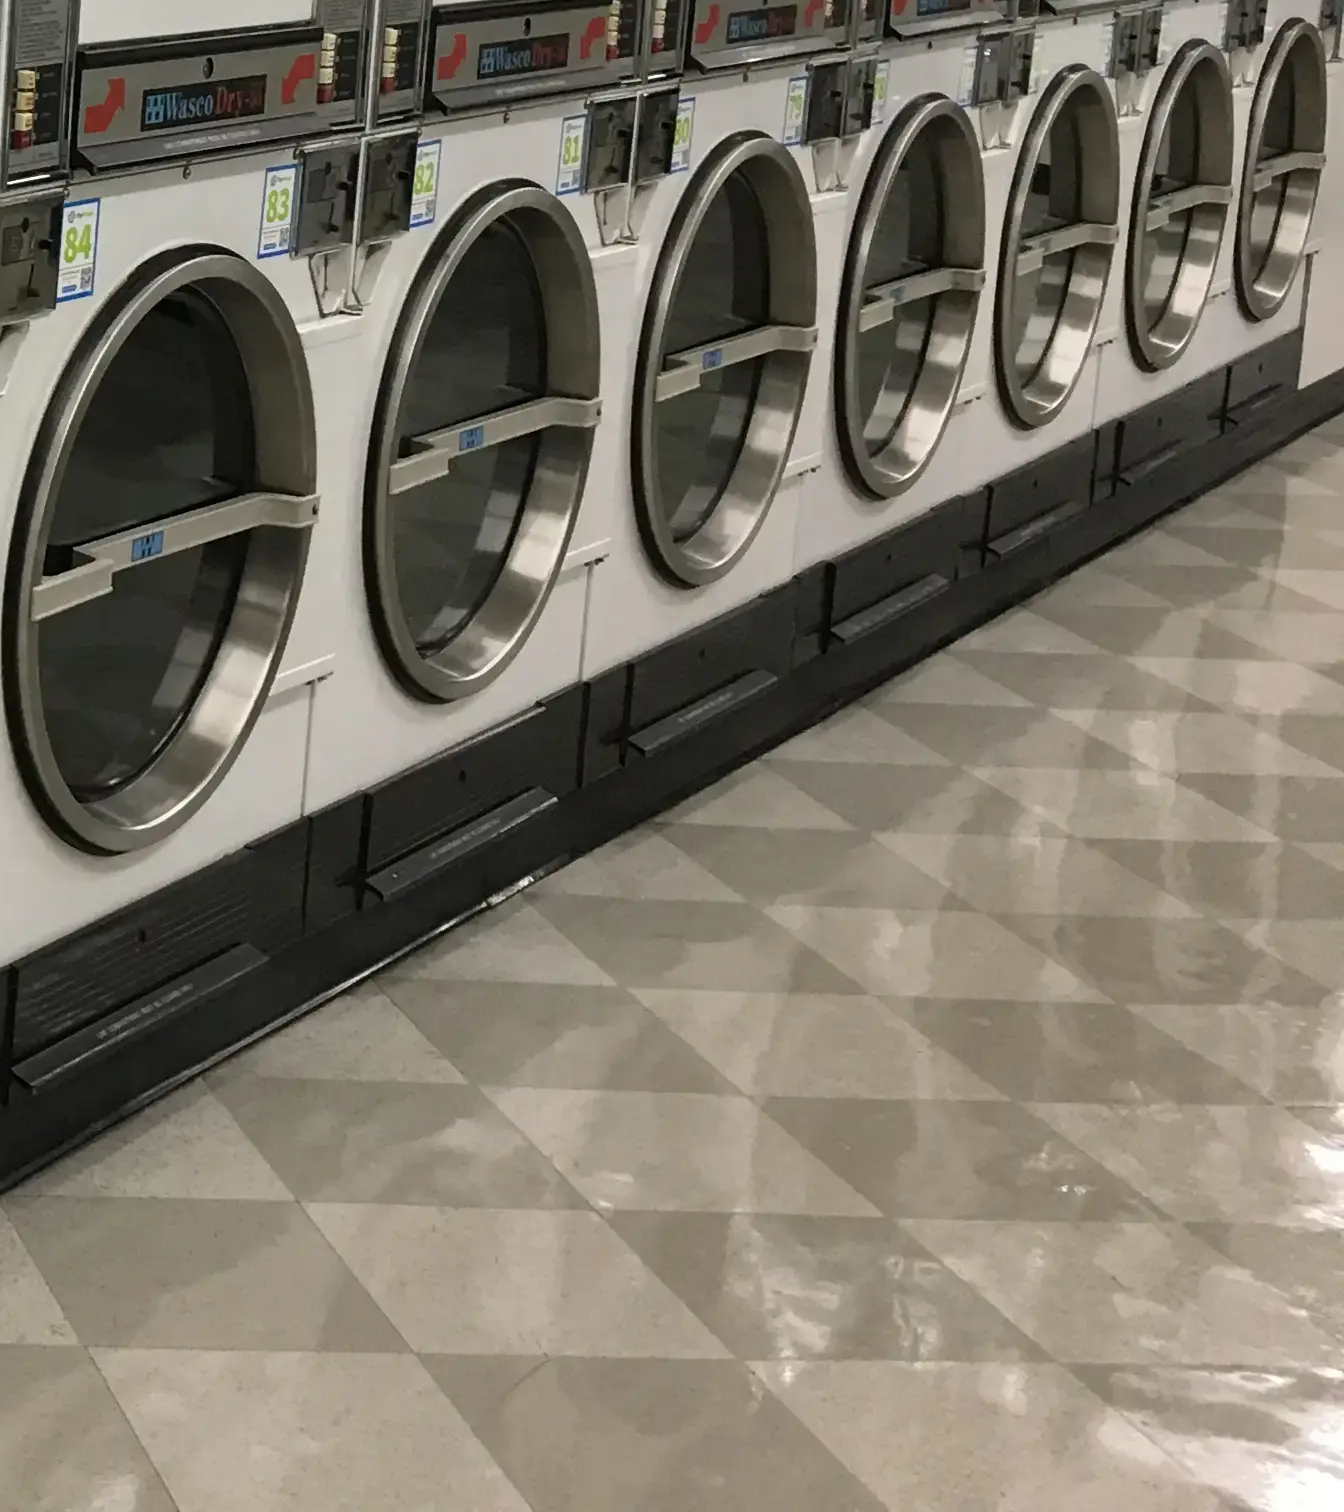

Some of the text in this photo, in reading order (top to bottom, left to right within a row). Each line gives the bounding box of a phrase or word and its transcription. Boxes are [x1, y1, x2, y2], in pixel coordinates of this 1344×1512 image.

[166, 90, 215, 121] Wasco
[413, 161, 435, 195] 82
[265, 187, 290, 223] 83
[63, 223, 92, 264] 84
